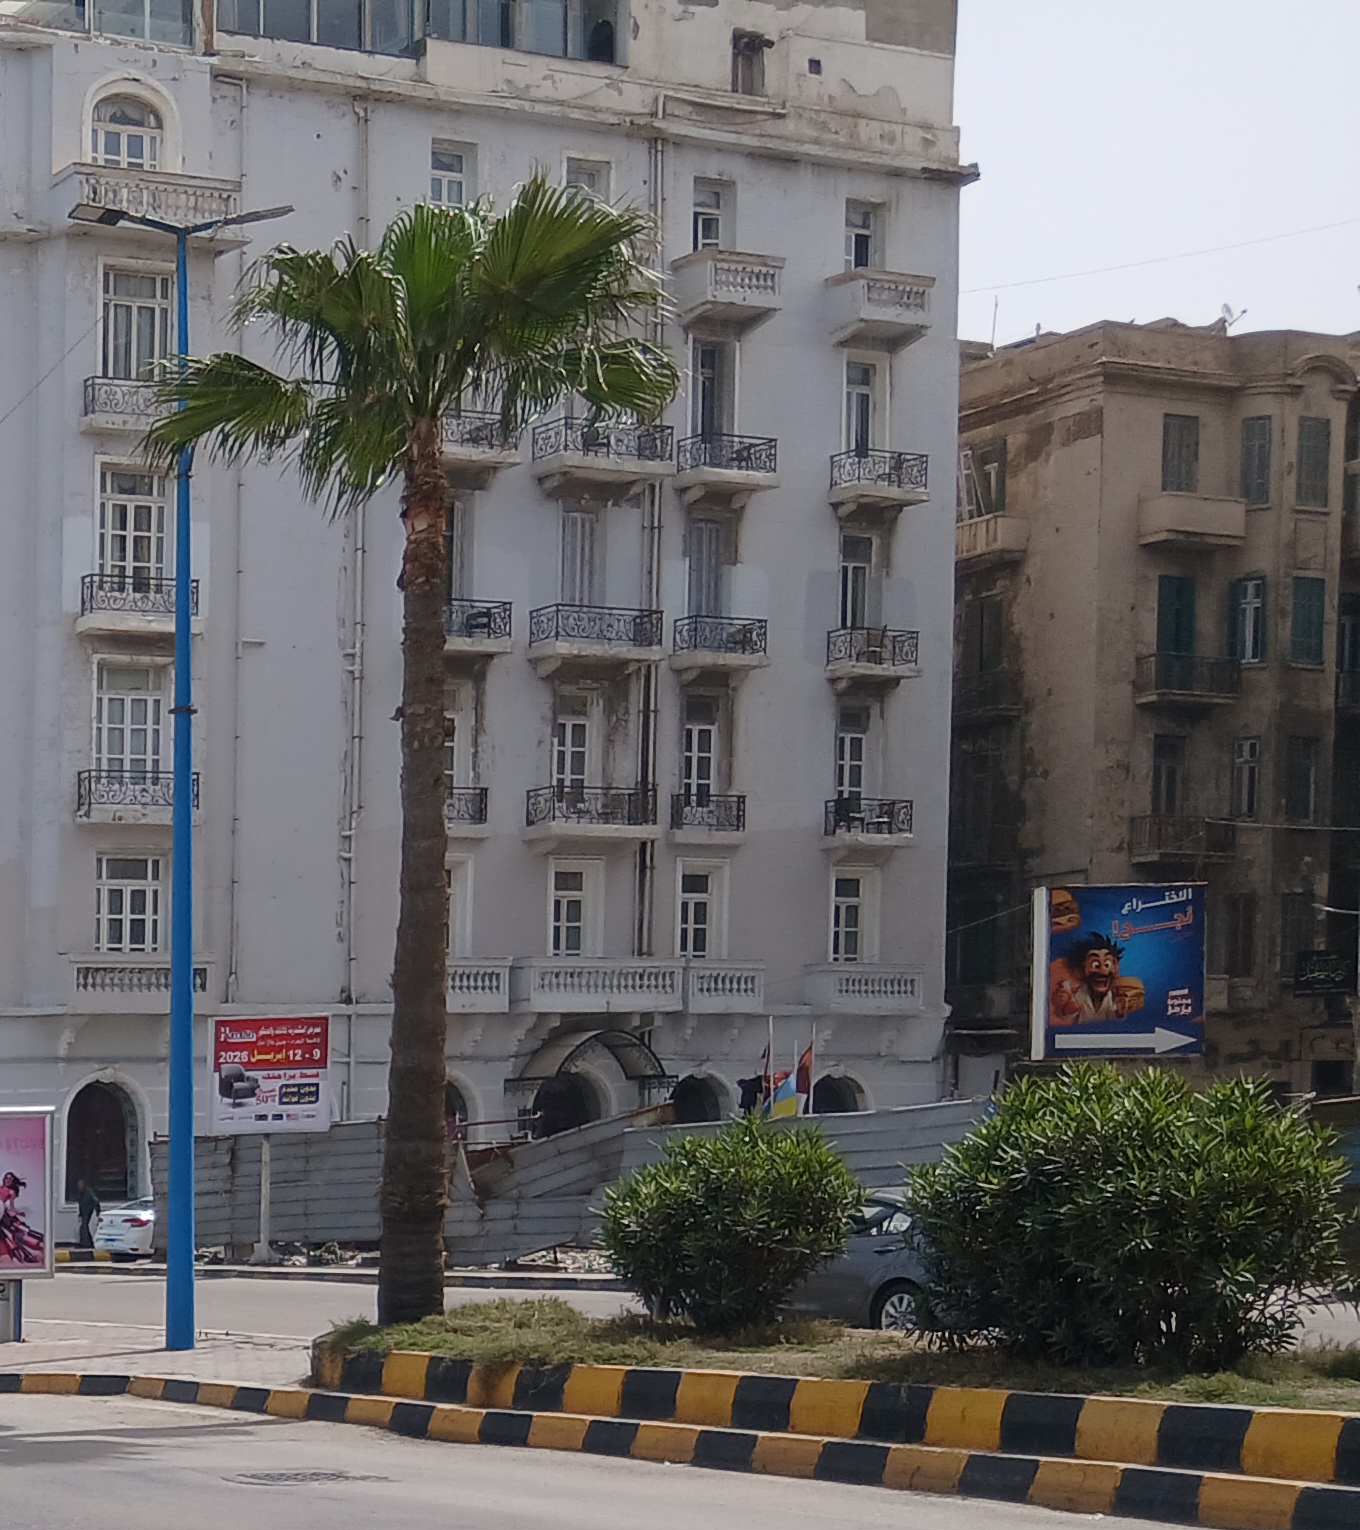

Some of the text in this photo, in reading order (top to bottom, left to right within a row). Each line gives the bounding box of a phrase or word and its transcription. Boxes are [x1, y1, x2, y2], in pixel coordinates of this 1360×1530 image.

[1121, 888, 1192, 915] الاختراع
[1112, 905, 1193, 940] نجح!
[219, 1051, 249, 1062] 2026
[287, 1049, 302, 1061] 12
